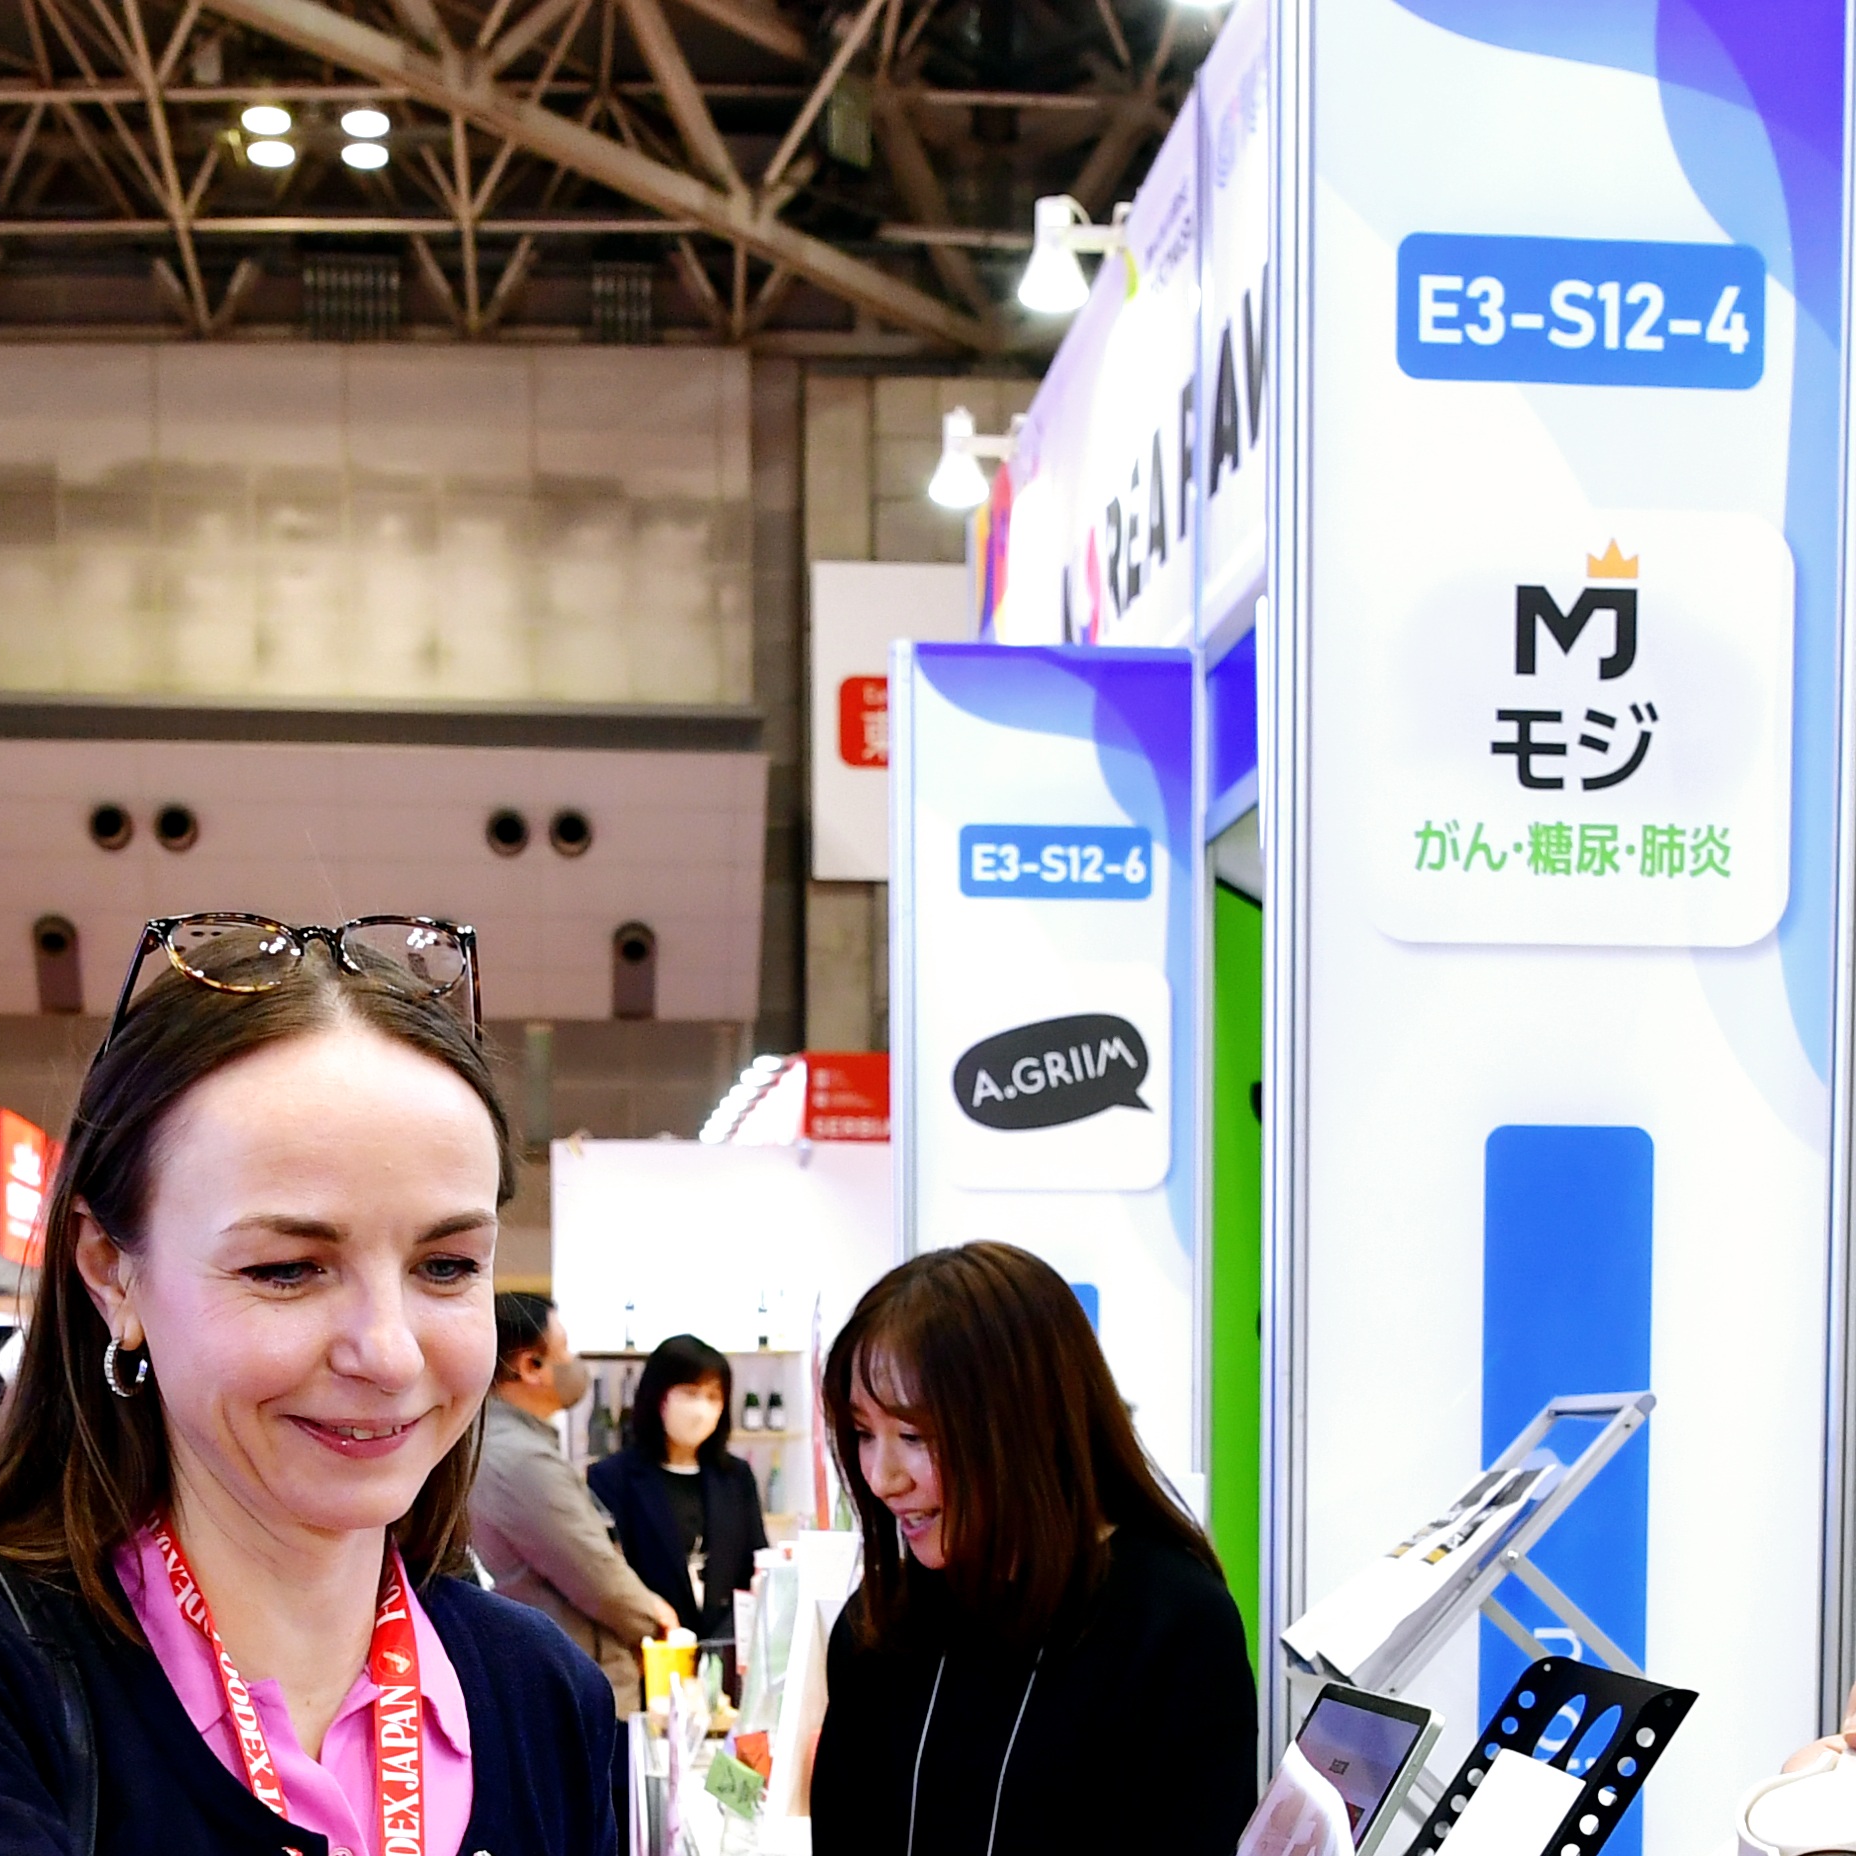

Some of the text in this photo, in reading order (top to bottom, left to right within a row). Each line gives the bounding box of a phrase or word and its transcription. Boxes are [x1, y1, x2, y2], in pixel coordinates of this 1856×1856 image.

[1416, 272, 1753, 357] E3-S12-4
[1489, 701, 1660, 793] モジ
[969, 841, 1148, 886] E3-S12-6
[379, 1684, 419, 1793] JAPAN
